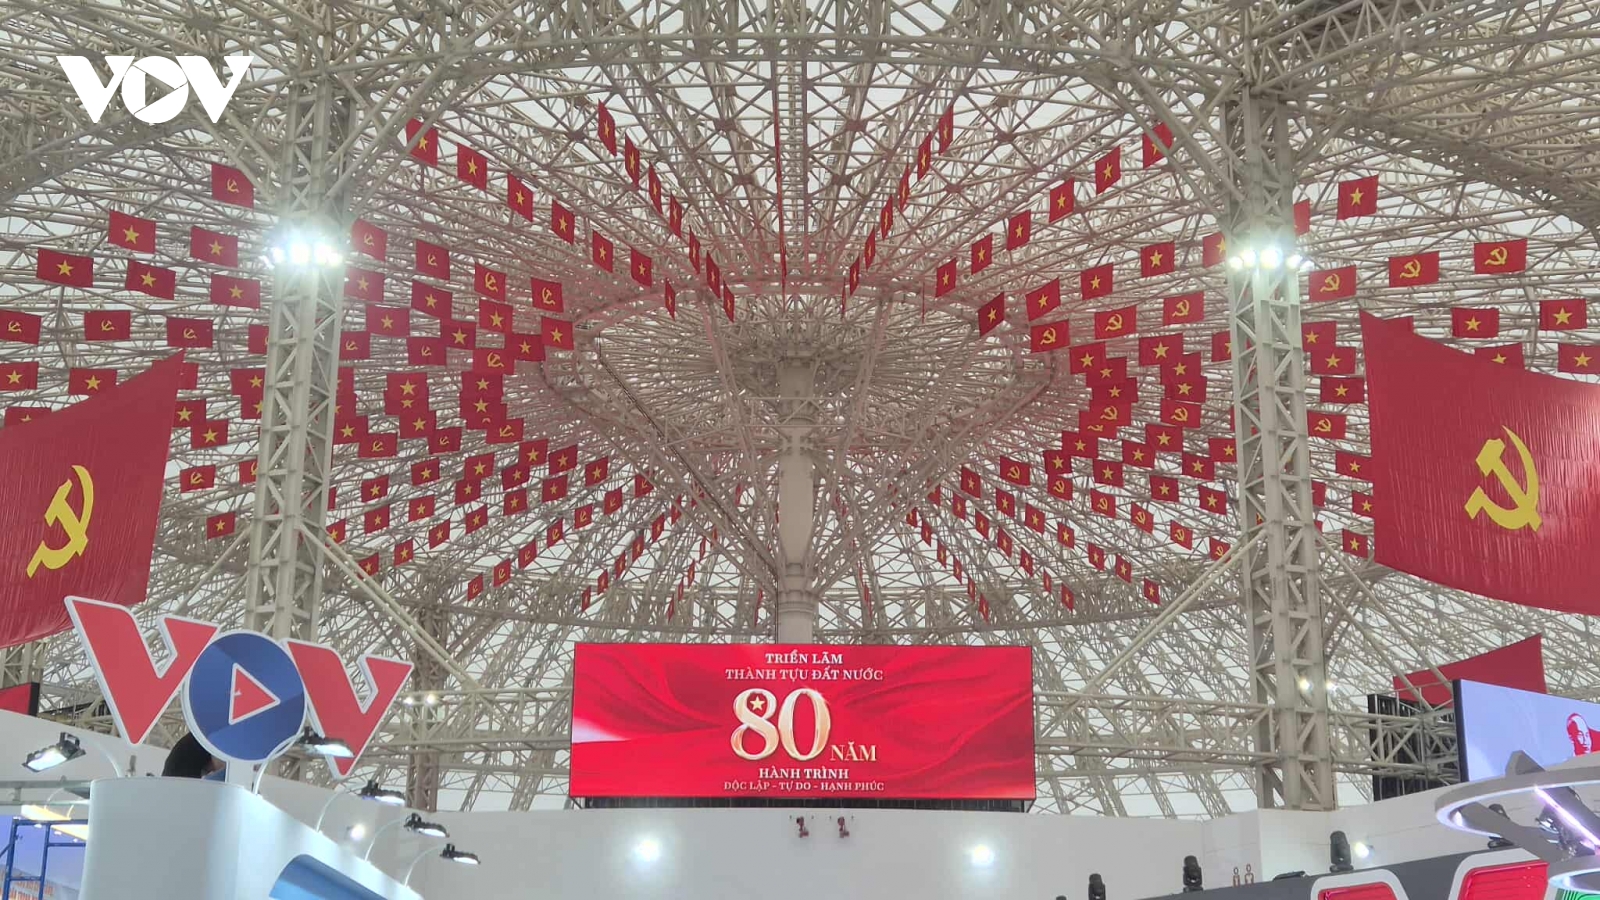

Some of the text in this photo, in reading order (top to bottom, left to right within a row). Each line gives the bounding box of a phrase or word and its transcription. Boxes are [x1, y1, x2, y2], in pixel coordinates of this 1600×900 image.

[765, 649, 843, 664] TRIỂN LÃM
[725, 665, 883, 682] THÀNH TỰU ĐẤT NƯỚC
[64, 595, 415, 780] VOV
[730, 688, 831, 761] 80
[830, 741, 877, 761] NĂM
[759, 765, 849, 779] HÀNH TRÌNH
[724, 779, 747, 791] ĐỘC
[749, 779, 770, 791] LẬP
[779, 780, 793, 792] TỰ
[795, 781, 811, 791] DO
[820, 781, 851, 792] HẠNH
[855, 780, 884, 791] PHÚC
